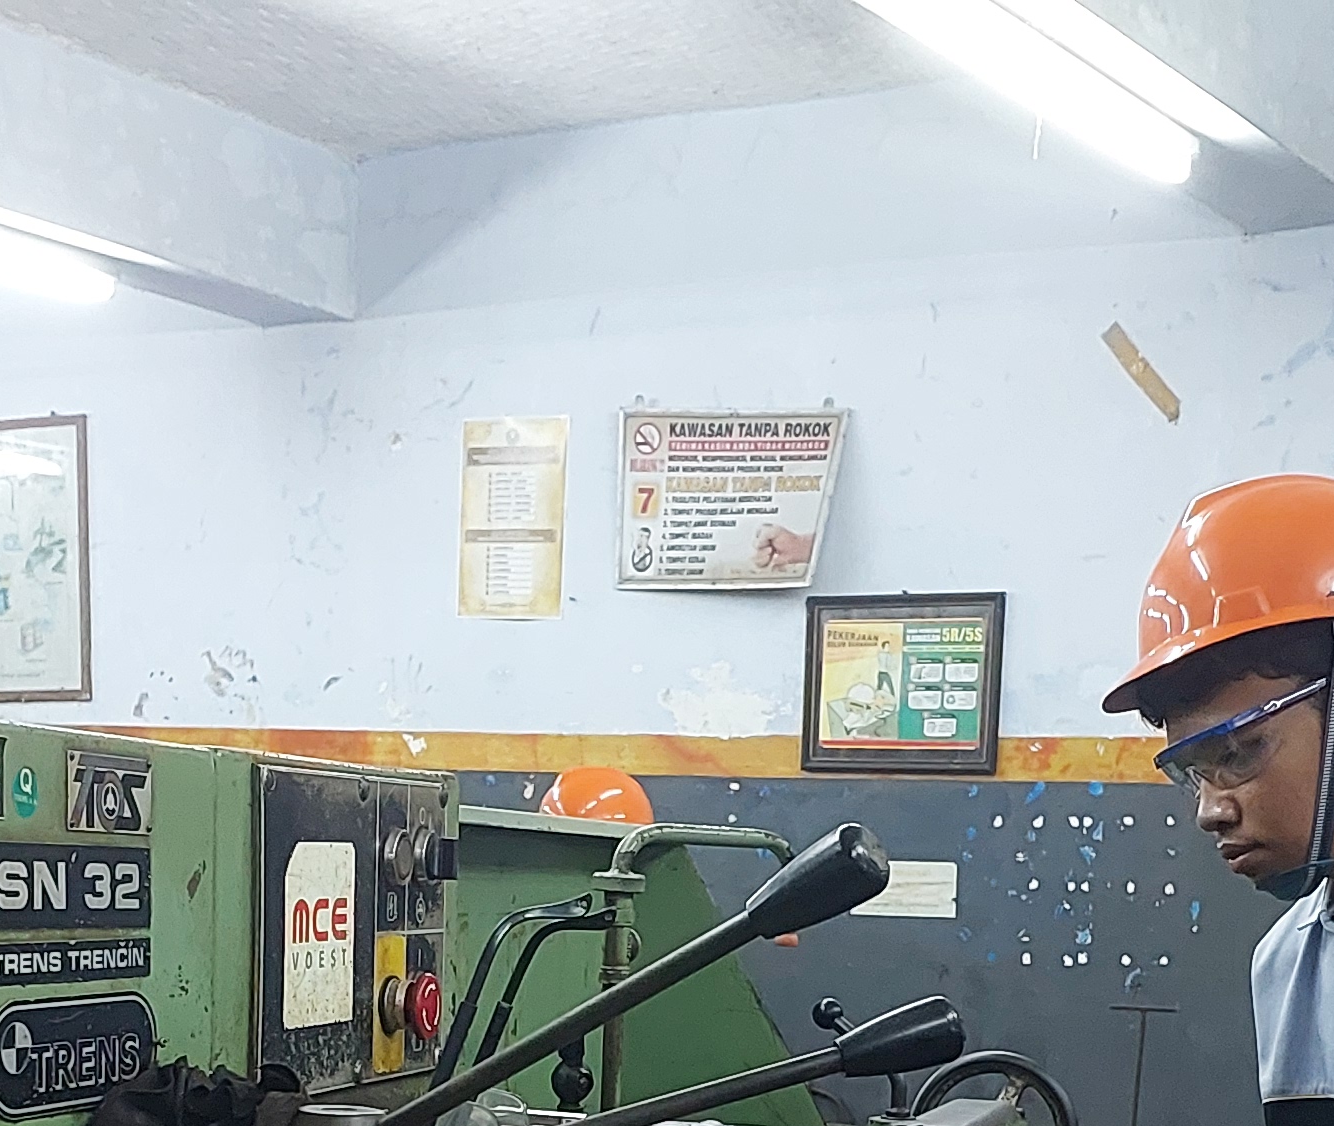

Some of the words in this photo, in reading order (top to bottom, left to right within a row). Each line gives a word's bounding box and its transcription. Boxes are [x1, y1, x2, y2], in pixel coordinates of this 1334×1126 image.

[669, 422, 734, 439] KAWASAN
[738, 422, 780, 438] TANPA
[783, 422, 833, 437] ROKOK
[637, 487, 655, 514] 7
[941, 627, 983, 642] 5R/5S
[20, 768, 33, 796] Q
[83, 862, 141, 911] 32
[291, 897, 348, 944] MCE
[67, 941, 145, 972] TRENČÍN
[291, 947, 347, 971] VOEST
[30, 1032, 141, 1093] TRENS
